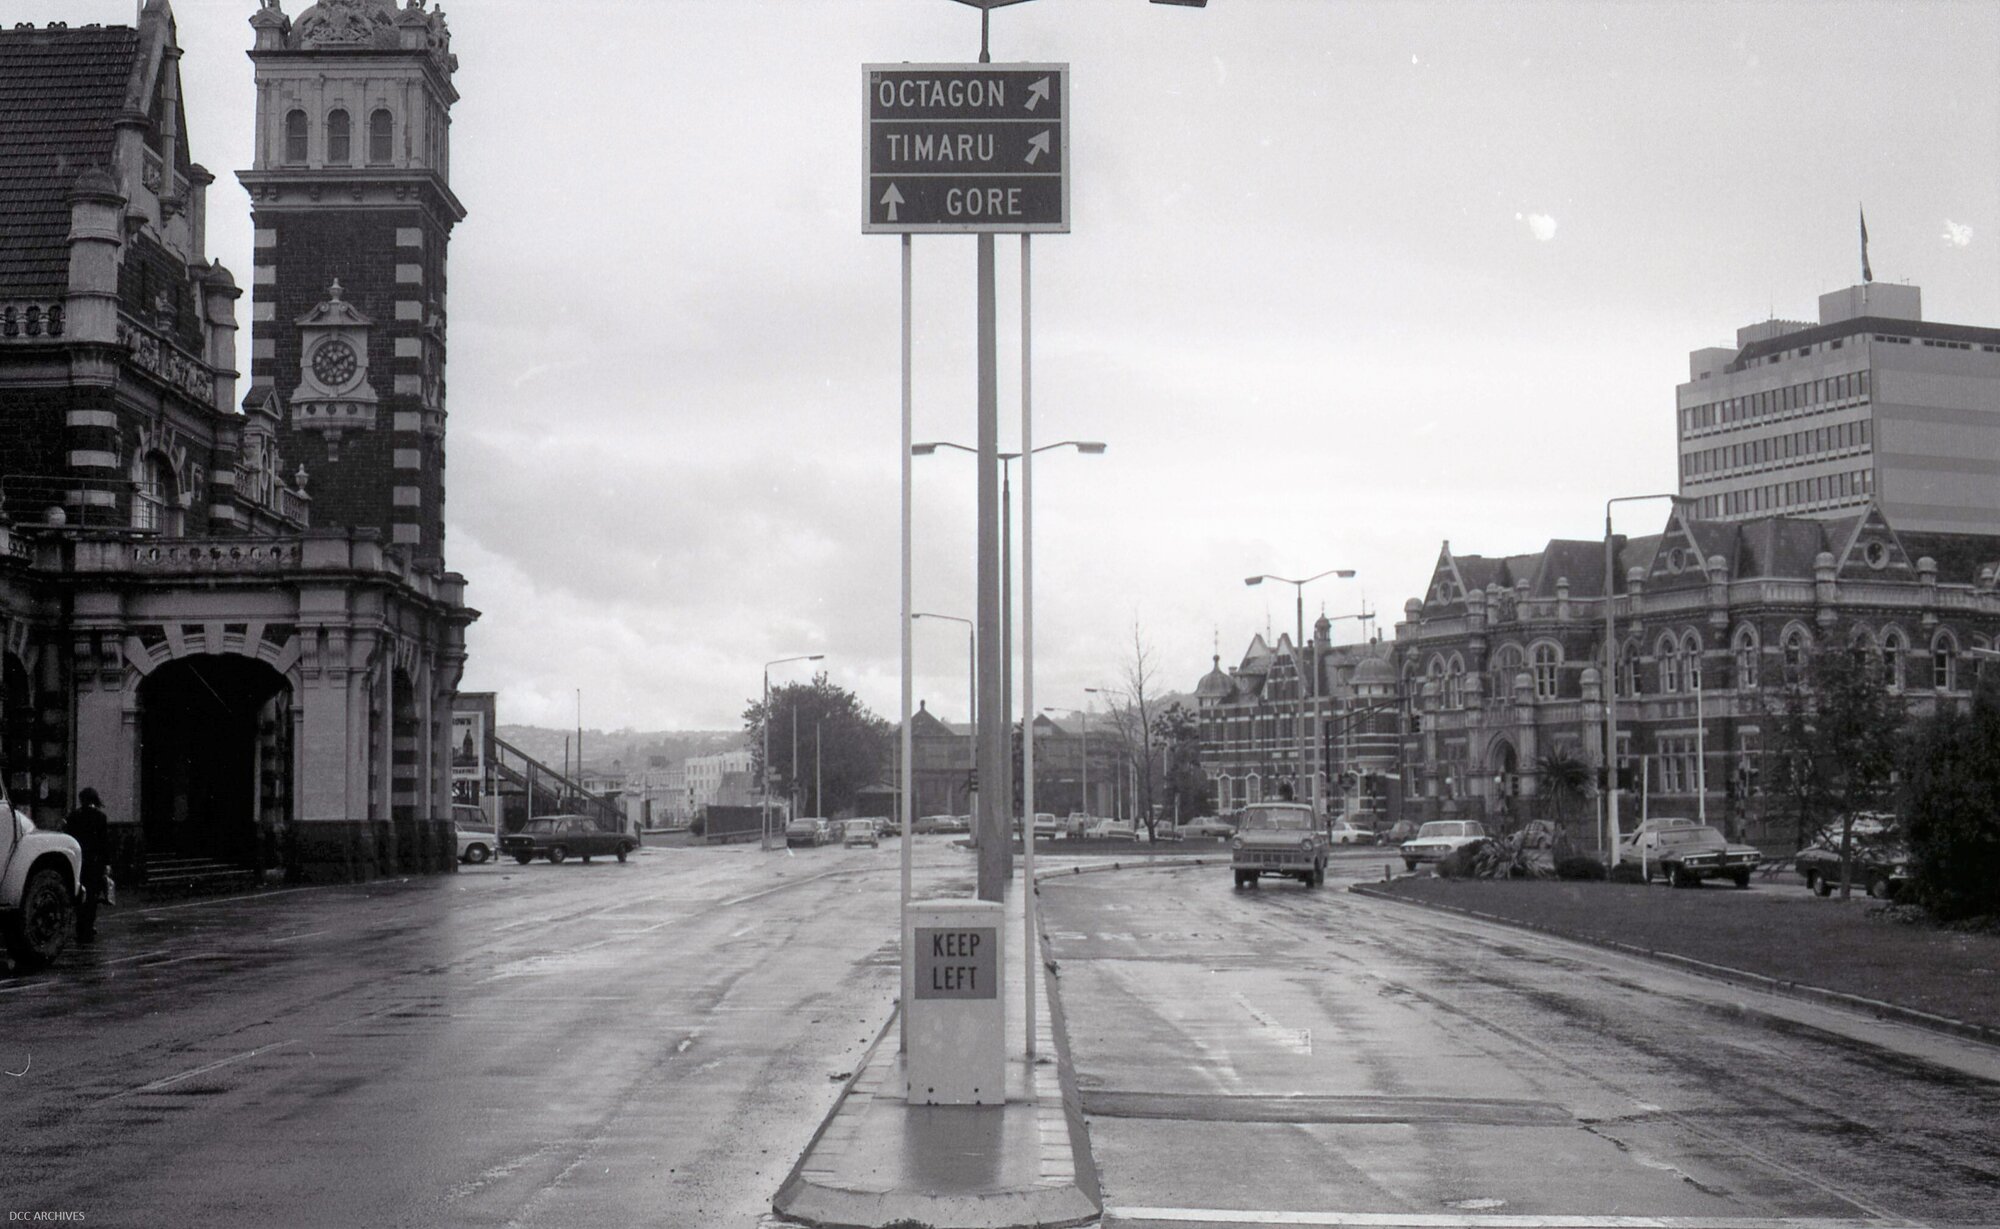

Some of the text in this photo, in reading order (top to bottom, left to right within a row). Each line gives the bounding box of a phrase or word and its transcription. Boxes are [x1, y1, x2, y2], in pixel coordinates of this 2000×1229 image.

[879, 79, 1005, 107] OCTAGON
[886, 133, 994, 161] TIMARU
[946, 187, 1023, 215] GORE
[933, 933, 980, 957] KEEP
[933, 966, 977, 990] LEFT
